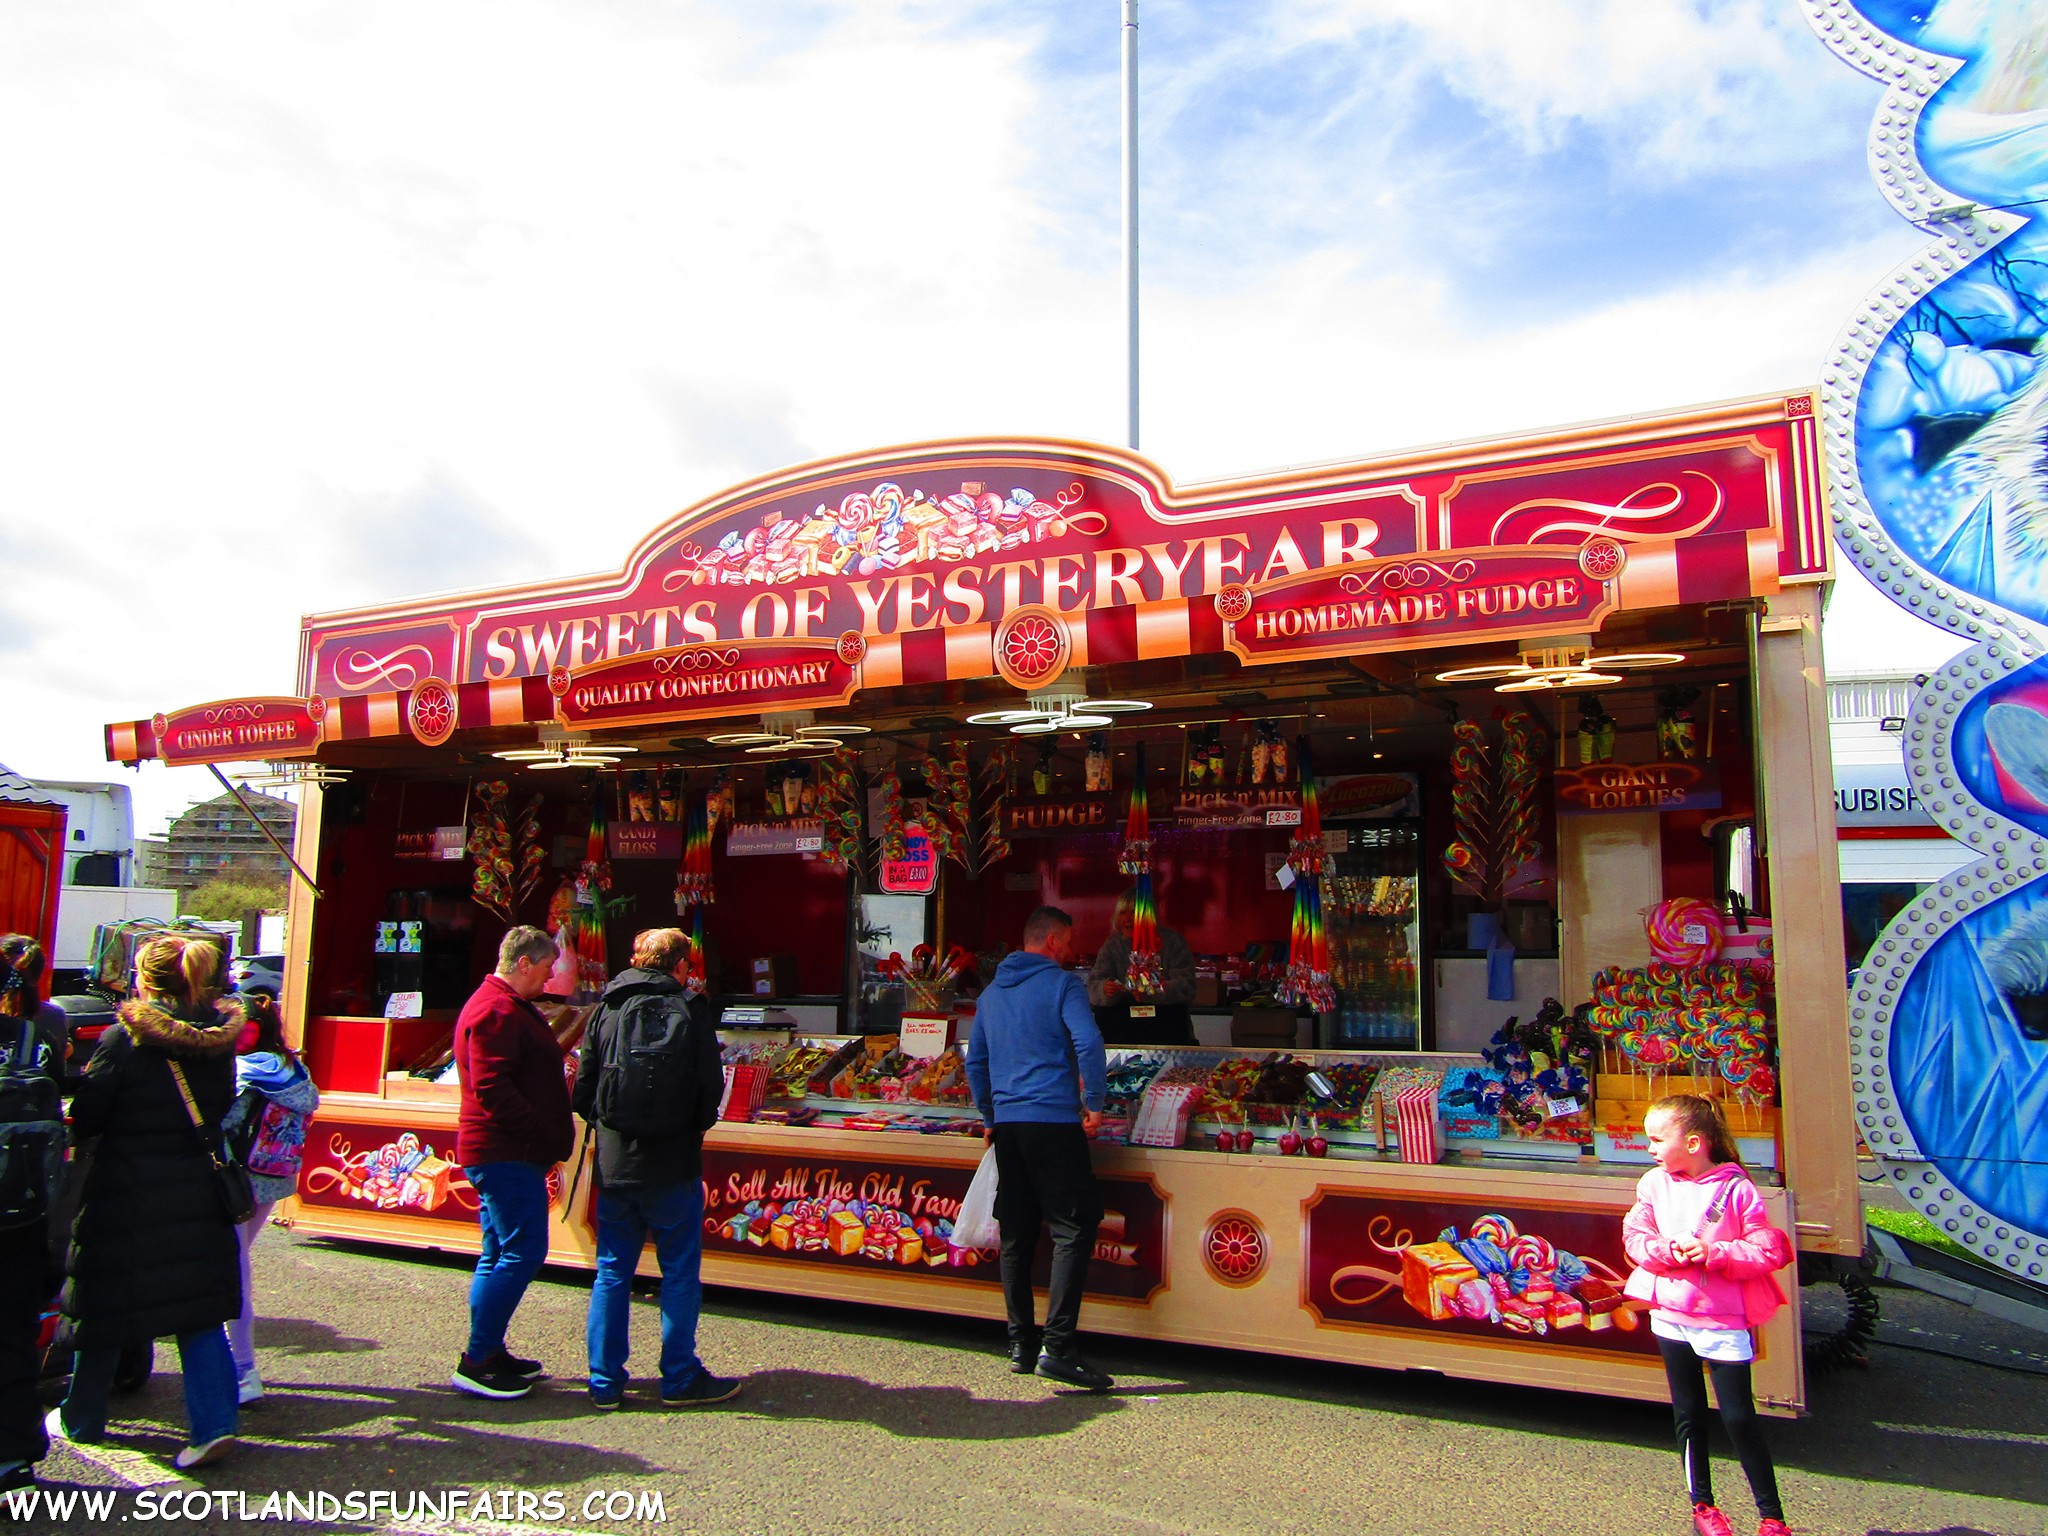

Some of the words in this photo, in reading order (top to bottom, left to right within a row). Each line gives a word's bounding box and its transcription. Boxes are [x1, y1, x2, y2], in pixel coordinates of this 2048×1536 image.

[482, 600, 718, 679] SWEETS
[740, 584, 832, 640] OF
[846, 517, 1380, 636] YESTERYEAR
[1255, 593, 1447, 639] HOMEMADE
[1458, 577, 1579, 618] FUDGE
[574, 681, 658, 713] QUALITY
[659, 661, 832, 700] CONFECTIONARY
[177, 730, 233, 750] CINDER
[236, 720, 297, 744] TOFFEE
[1601, 769, 1669, 787] GIANT
[1589, 788, 1686, 809] LOLLIES
[1833, 788, 1924, 812] UBISH
[1011, 801, 1107, 830] FUDGE
[1178, 815, 1235, 827] Finger-Free
[1236, 813, 1262, 825] Zone
[618, 827, 657, 839] CANDY
[619, 842, 657, 855] FLOSS
[889, 866, 897, 875] IN
[900, 865, 906, 874] A
[889, 874, 908, 884] BAG
[726, 1169, 766, 1204] Sell
[771, 1167, 810, 1198] All
[815, 1168, 854, 1199] The
[861, 1171, 904, 1209] Old
